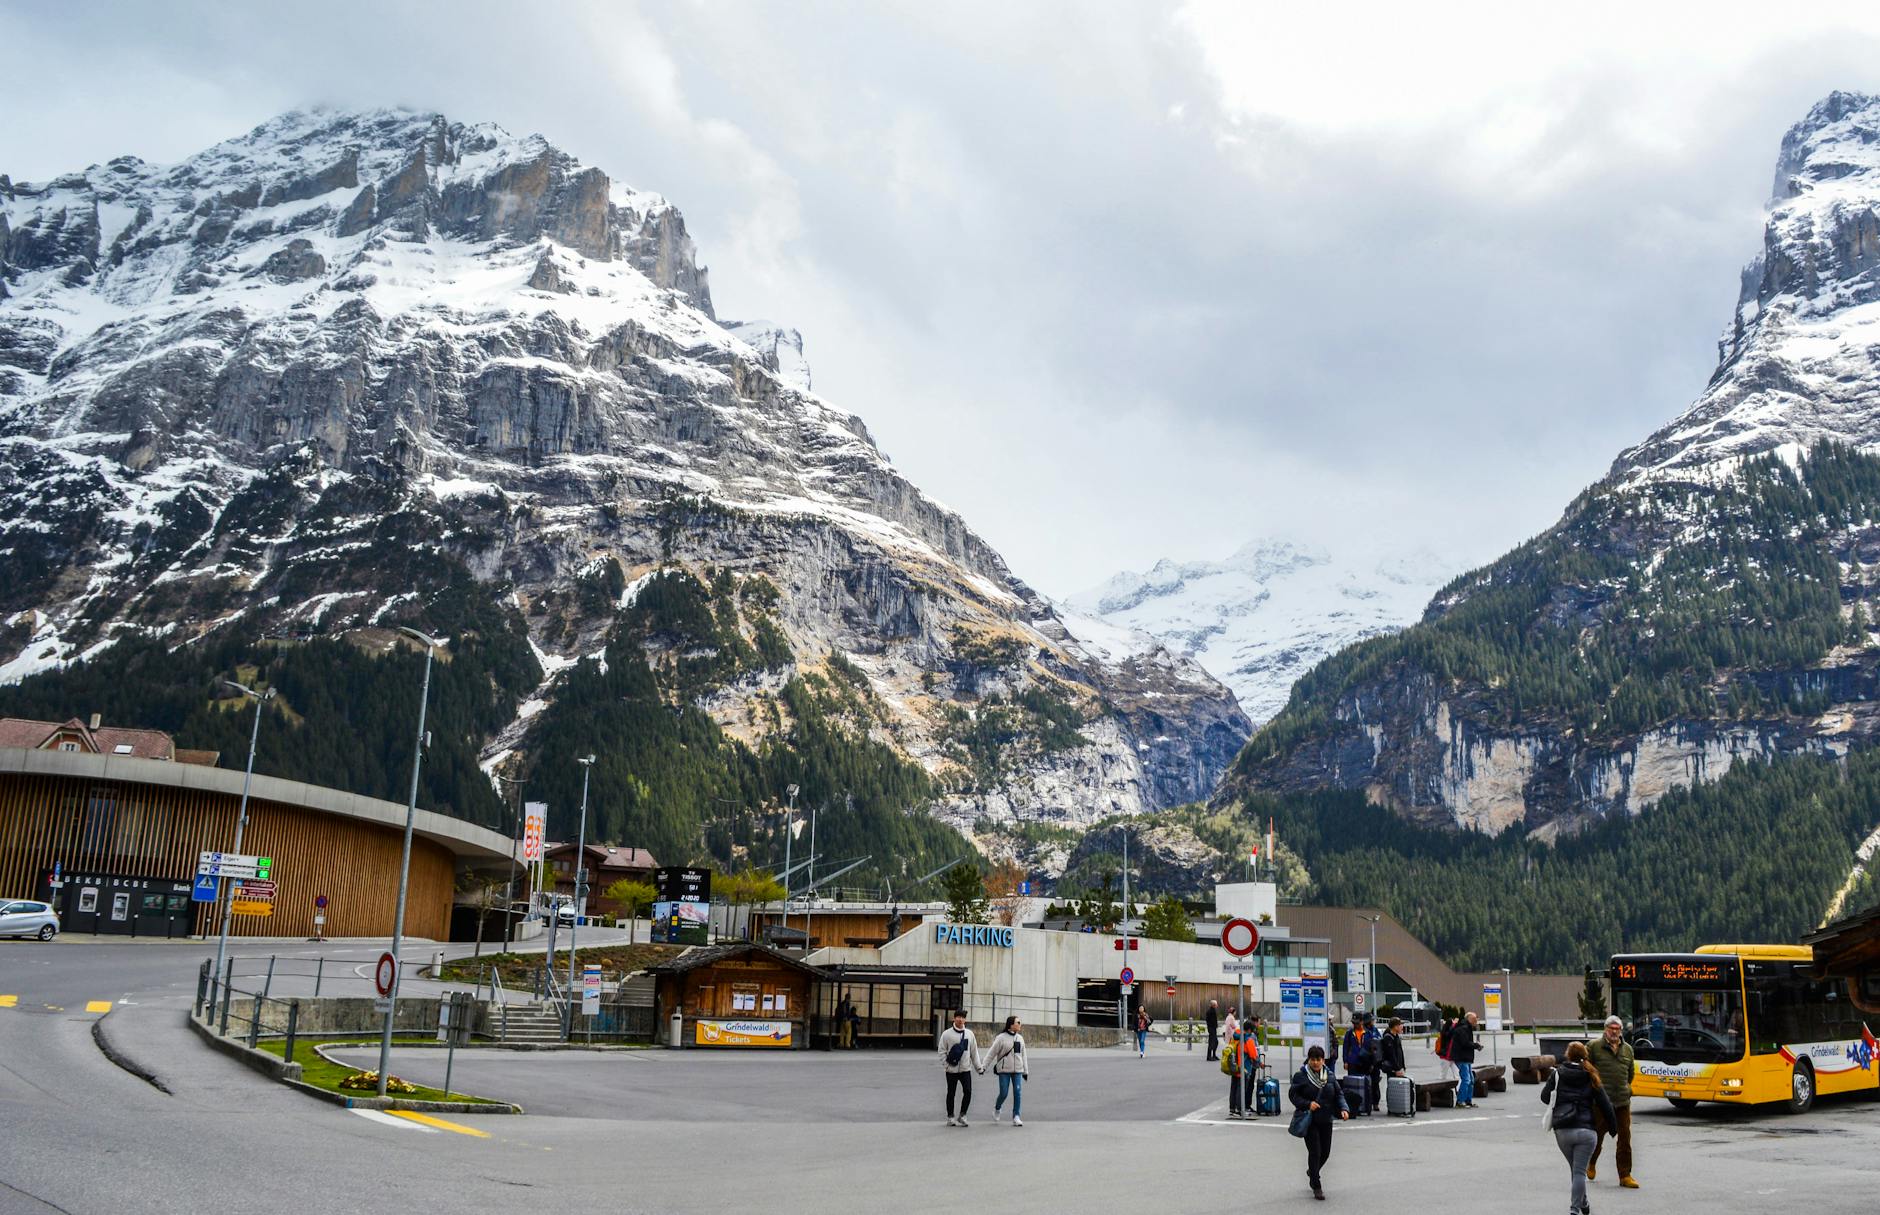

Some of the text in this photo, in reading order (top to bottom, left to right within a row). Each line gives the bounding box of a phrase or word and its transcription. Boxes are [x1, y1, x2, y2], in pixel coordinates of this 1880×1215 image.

[64, 876, 148, 888] BEKB BCBE
[173, 883, 191, 892] Bank
[936, 924, 1014, 948] PARKING
[1618, 965, 1636, 978] 121
